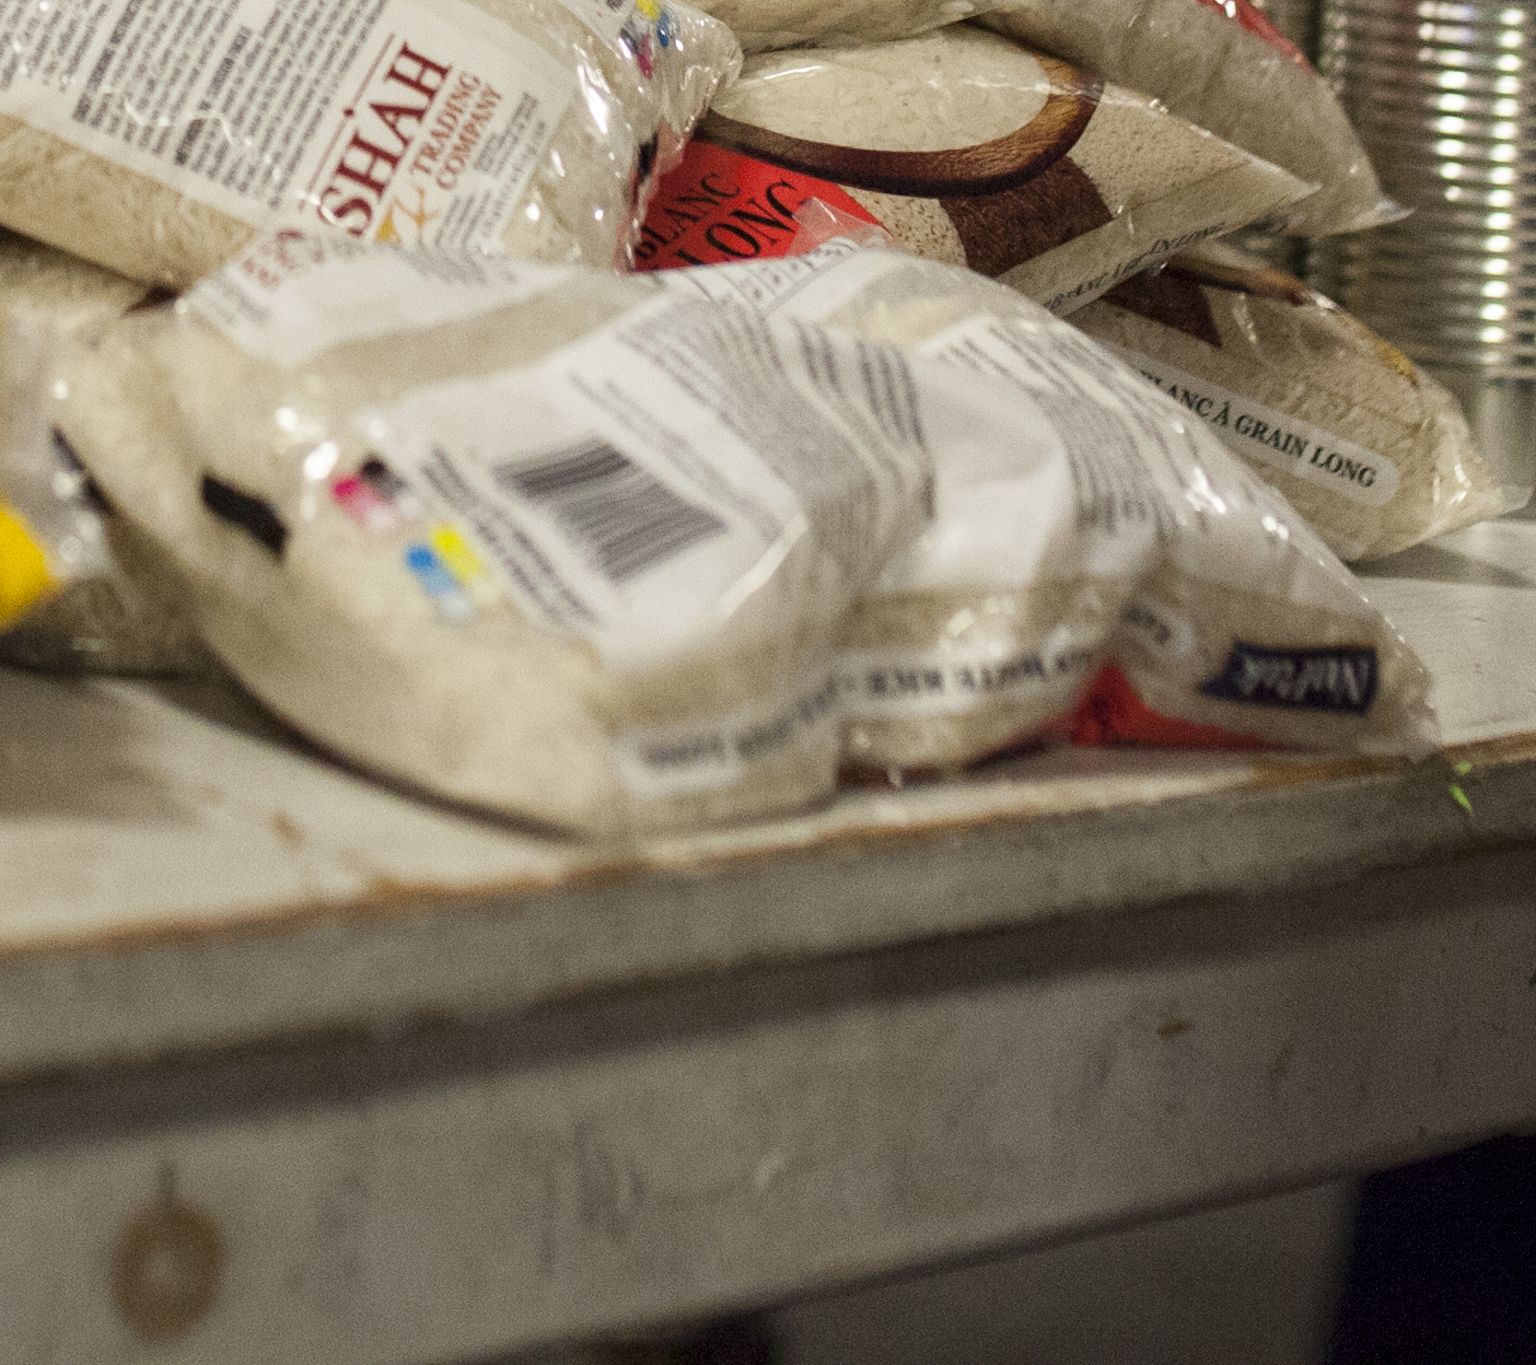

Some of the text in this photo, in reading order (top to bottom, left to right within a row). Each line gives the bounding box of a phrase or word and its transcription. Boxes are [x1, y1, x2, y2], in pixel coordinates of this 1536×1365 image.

[317, 41, 453, 237] SHAH
[411, 69, 482, 176] TRADING
[435, 82, 504, 191] COMPANY
[1210, 401, 1231, 429] À
[1234, 413, 1309, 459] GRAIN
[1310, 445, 1378, 488] LONG
